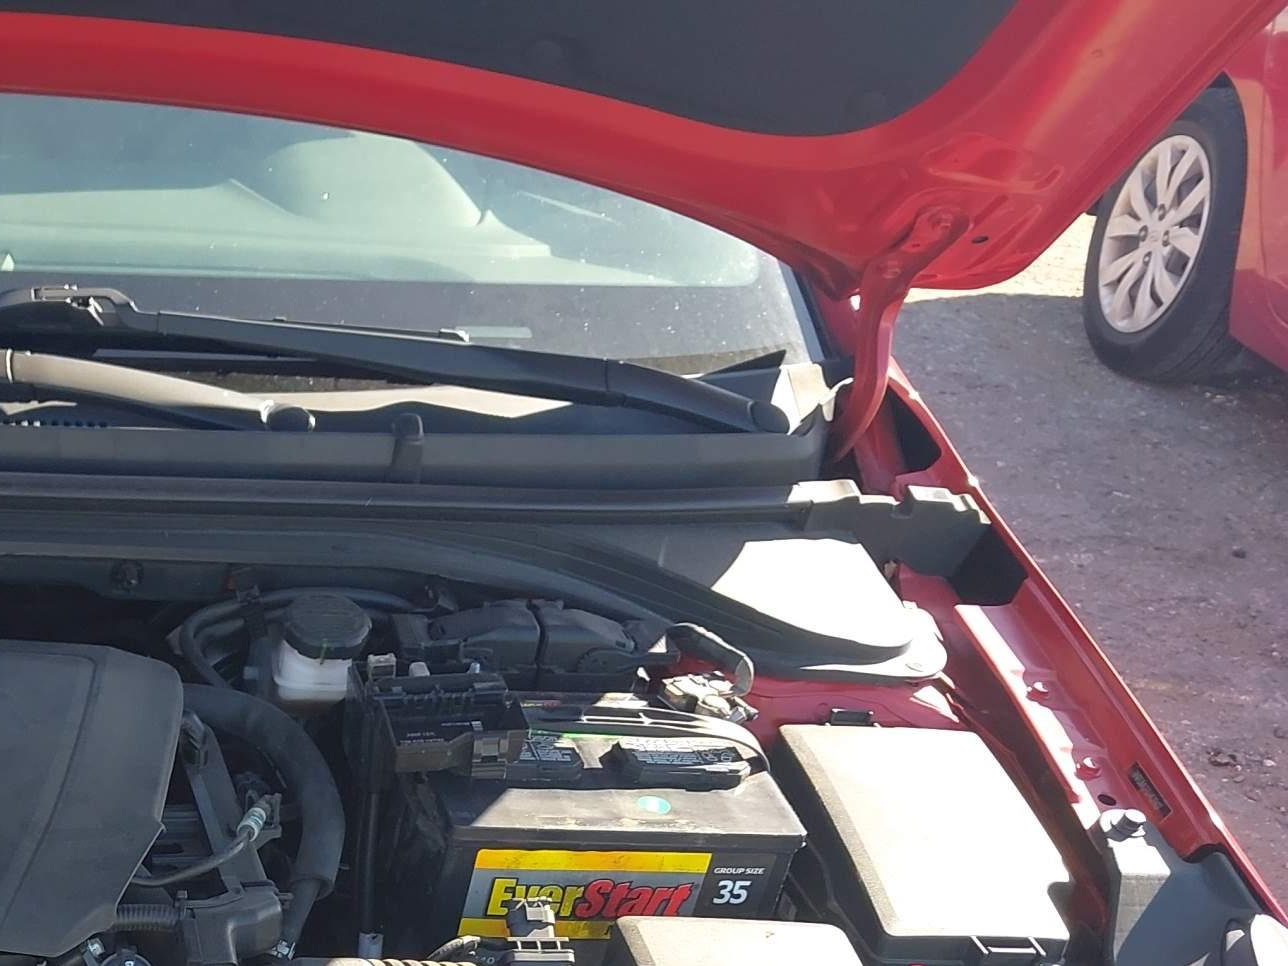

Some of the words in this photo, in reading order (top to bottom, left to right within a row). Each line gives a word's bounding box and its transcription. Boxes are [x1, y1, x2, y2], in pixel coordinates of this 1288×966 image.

[745, 867, 765, 875] SIZE
[486, 877, 693, 919] EverStart
[712, 880, 752, 904] 35
